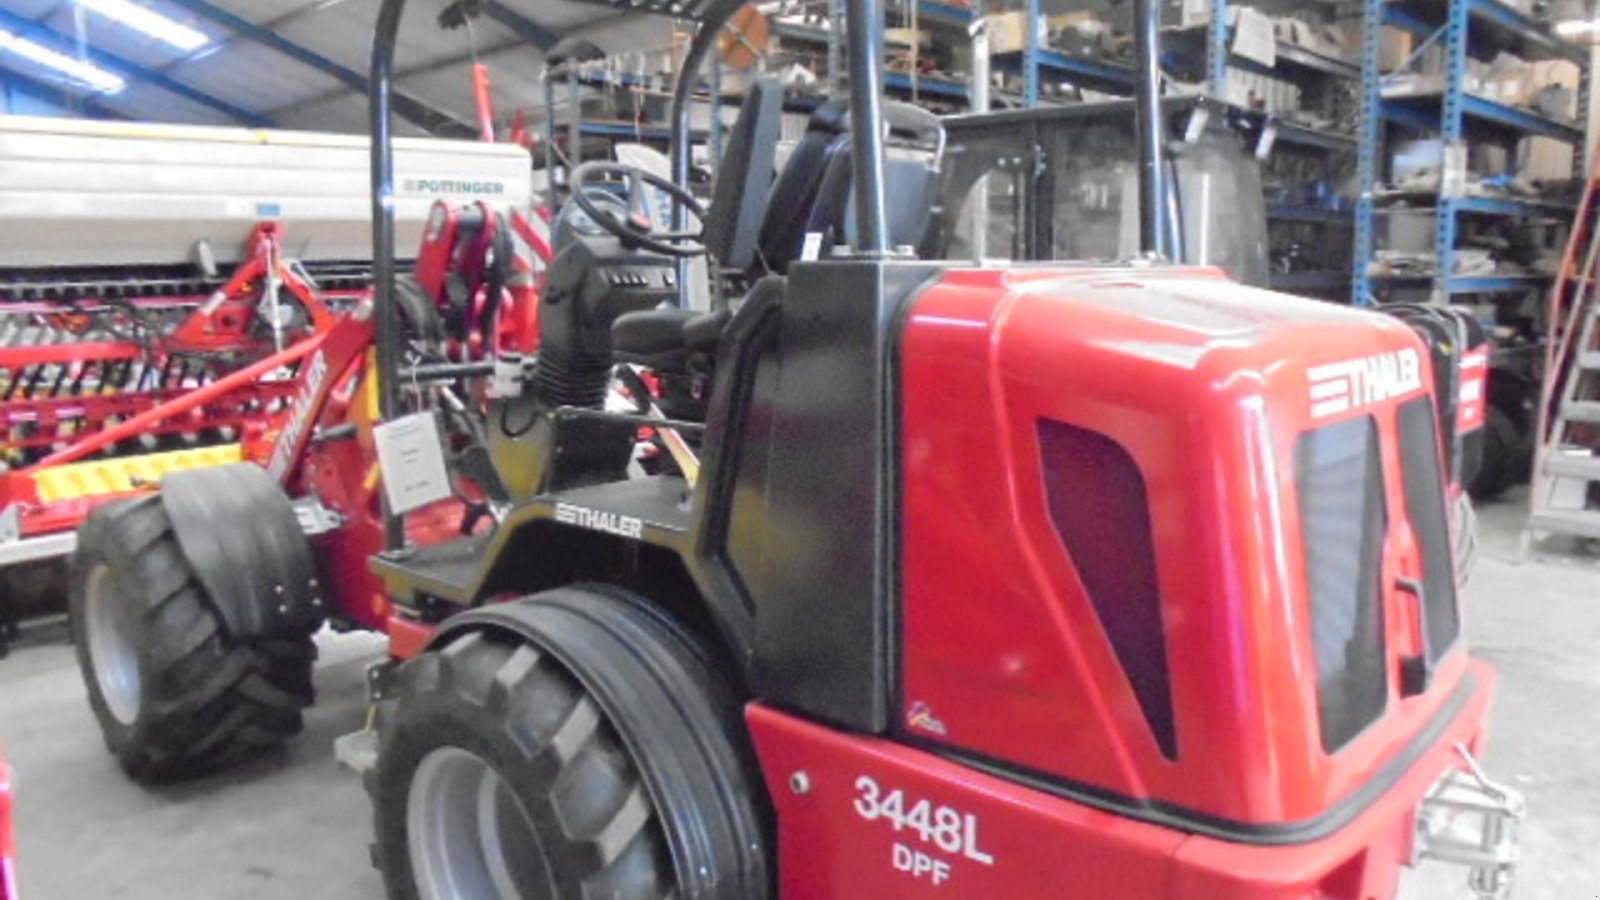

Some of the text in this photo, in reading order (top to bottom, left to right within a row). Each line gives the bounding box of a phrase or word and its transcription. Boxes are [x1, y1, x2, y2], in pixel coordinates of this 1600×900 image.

[1344, 348, 1423, 408] THALER
[577, 506, 642, 539] THALER
[854, 775, 994, 865] 3448L
[892, 842, 951, 886] DPF
